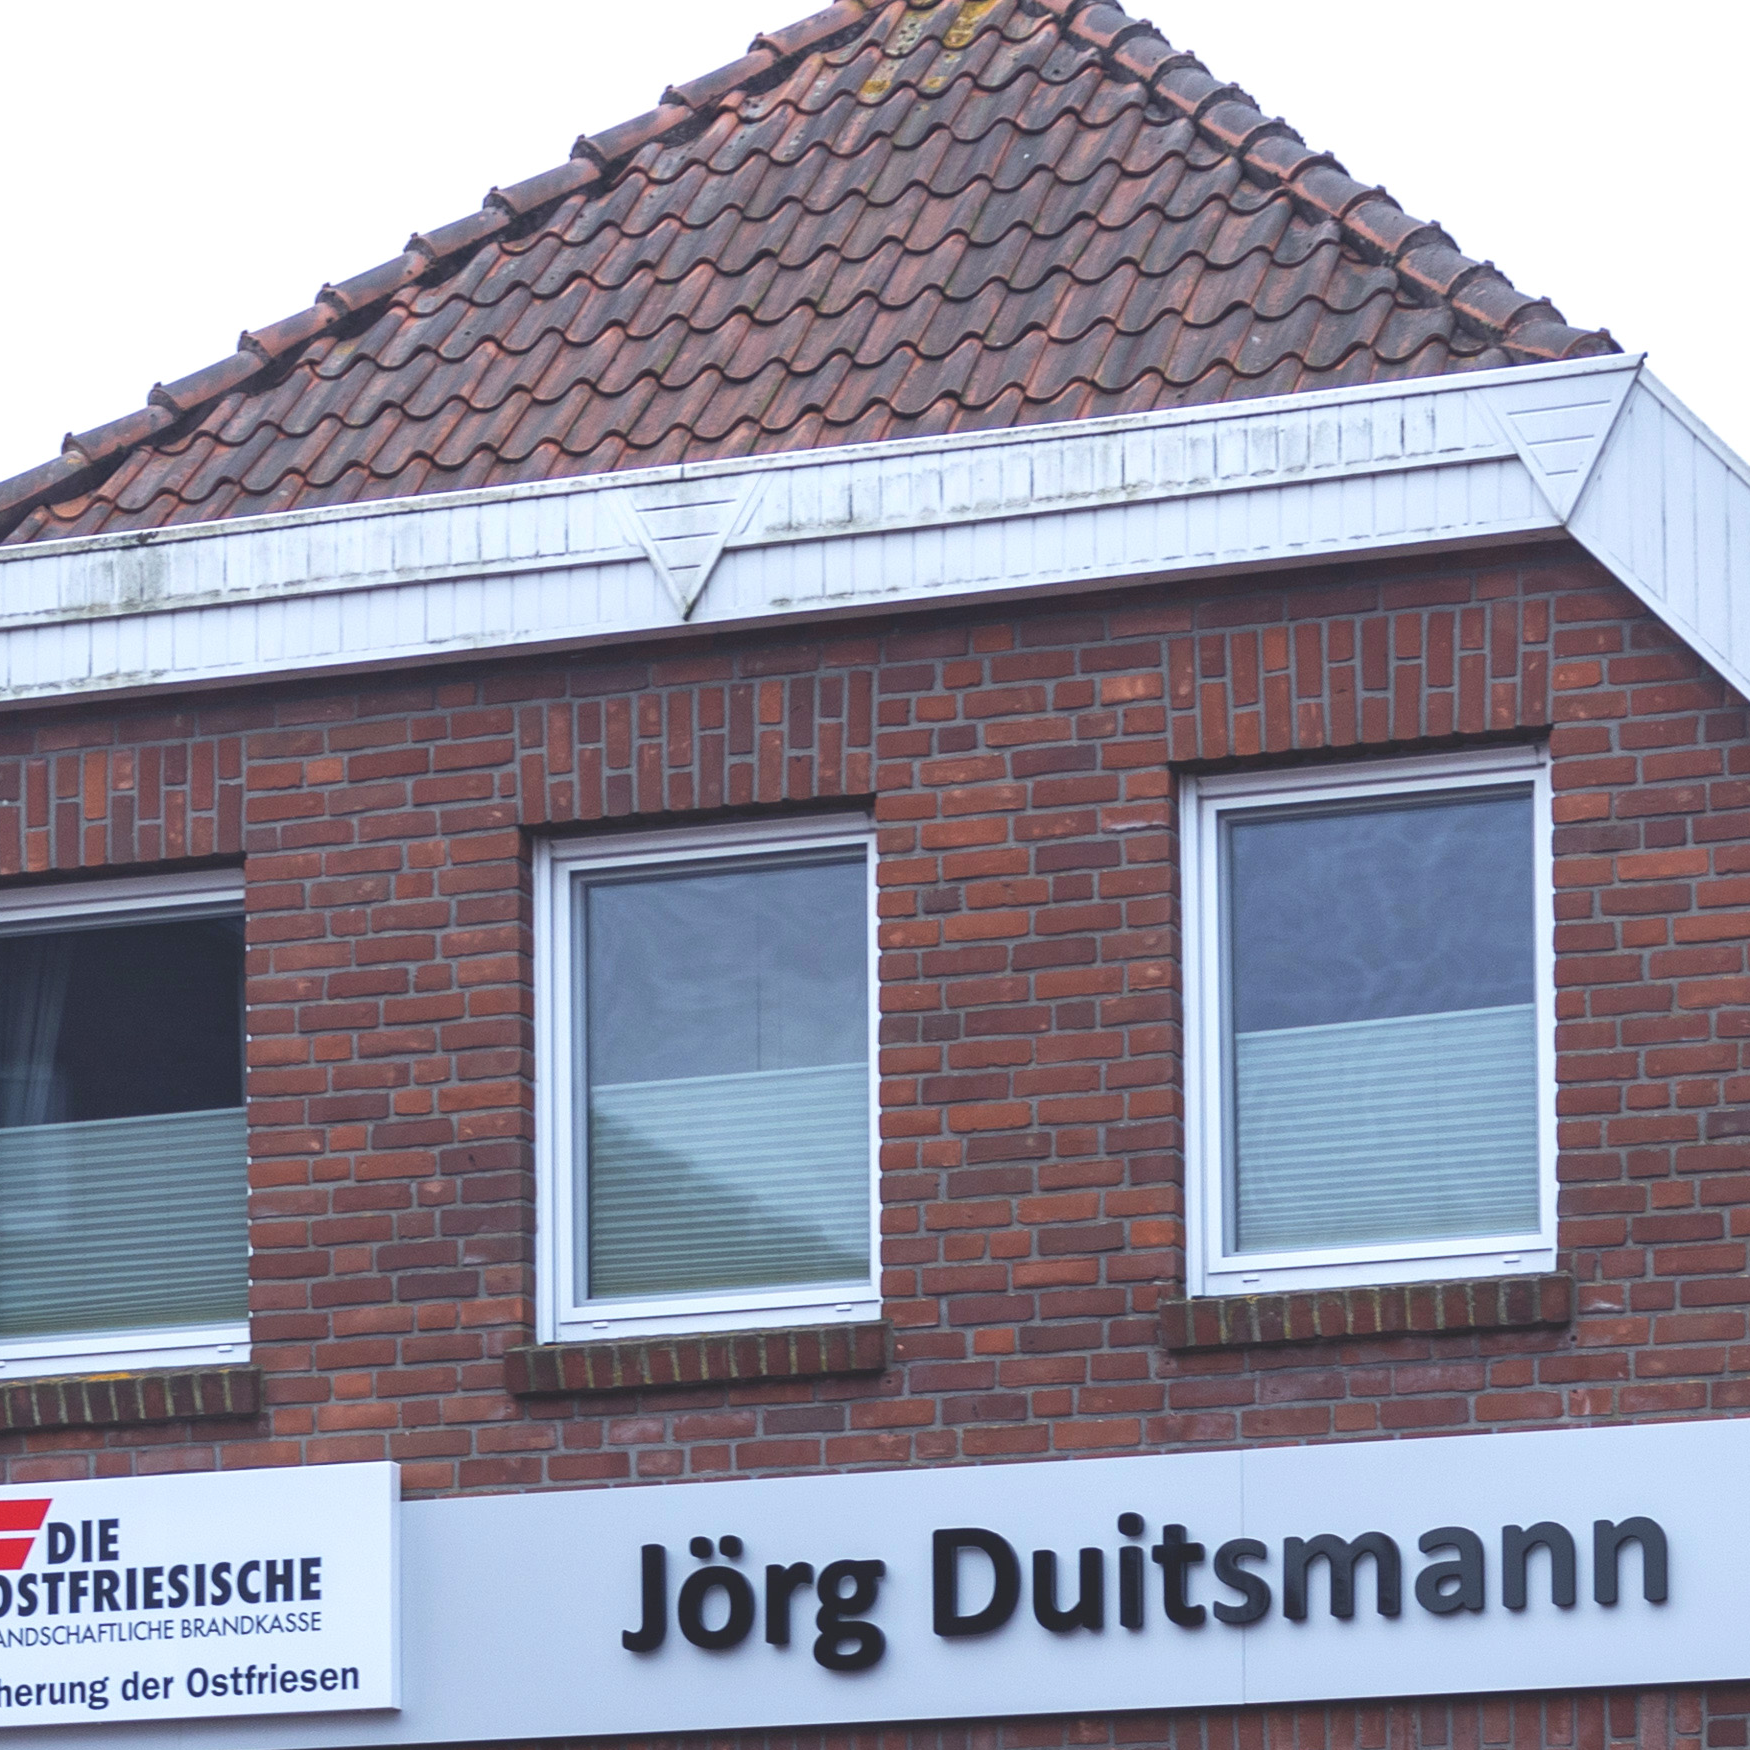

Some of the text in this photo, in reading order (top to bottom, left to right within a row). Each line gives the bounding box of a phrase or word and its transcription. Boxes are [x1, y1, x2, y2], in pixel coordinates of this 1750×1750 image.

[47, 1518, 120, 1565] DIE
[622, 1512, 1669, 1672] Jörg Duitsmann
[182, 1612, 322, 1638] BRANDKASSE
[121, 1671, 173, 1702] der
[187, 1664, 360, 1698] Ostfriesen
